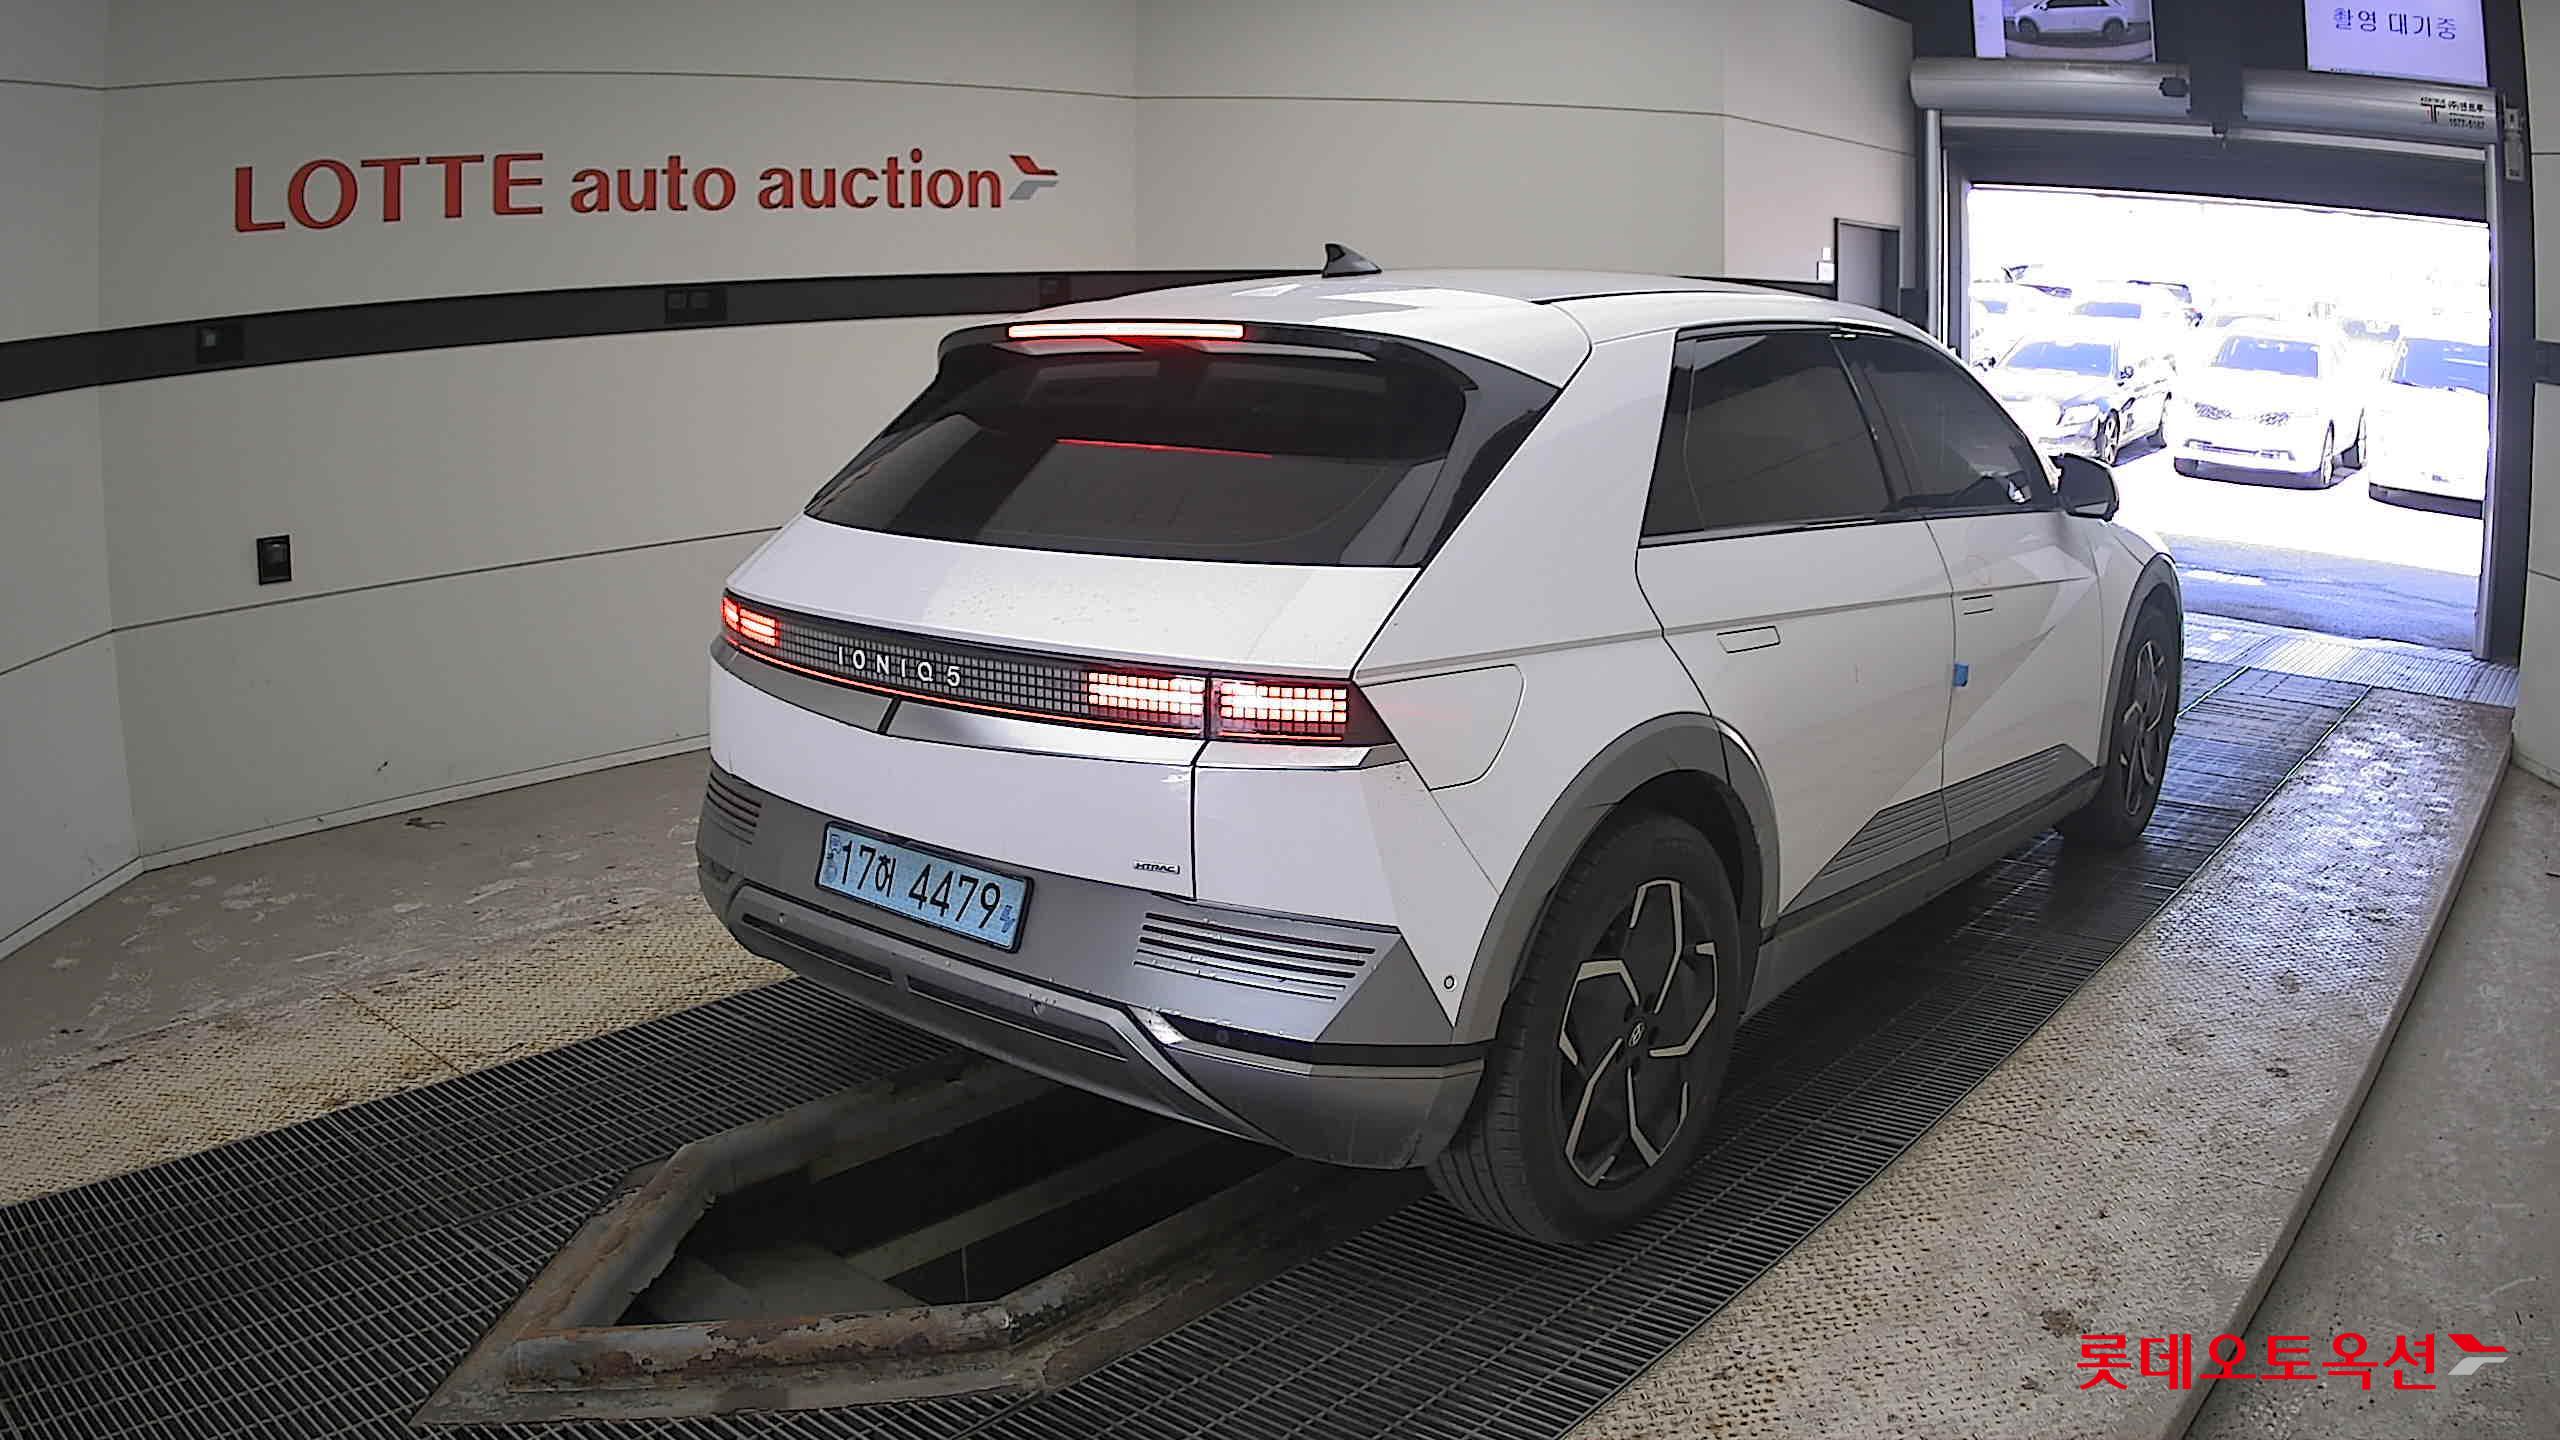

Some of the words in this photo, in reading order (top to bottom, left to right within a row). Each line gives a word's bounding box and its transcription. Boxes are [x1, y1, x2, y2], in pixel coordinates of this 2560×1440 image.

[2388, 13, 2456, 40] 대기중
[234, 152, 544, 233] LOTTE
[569, 155, 736, 213] auto
[757, 147, 1002, 210] auction
[908, 864, 1001, 929] 4479
